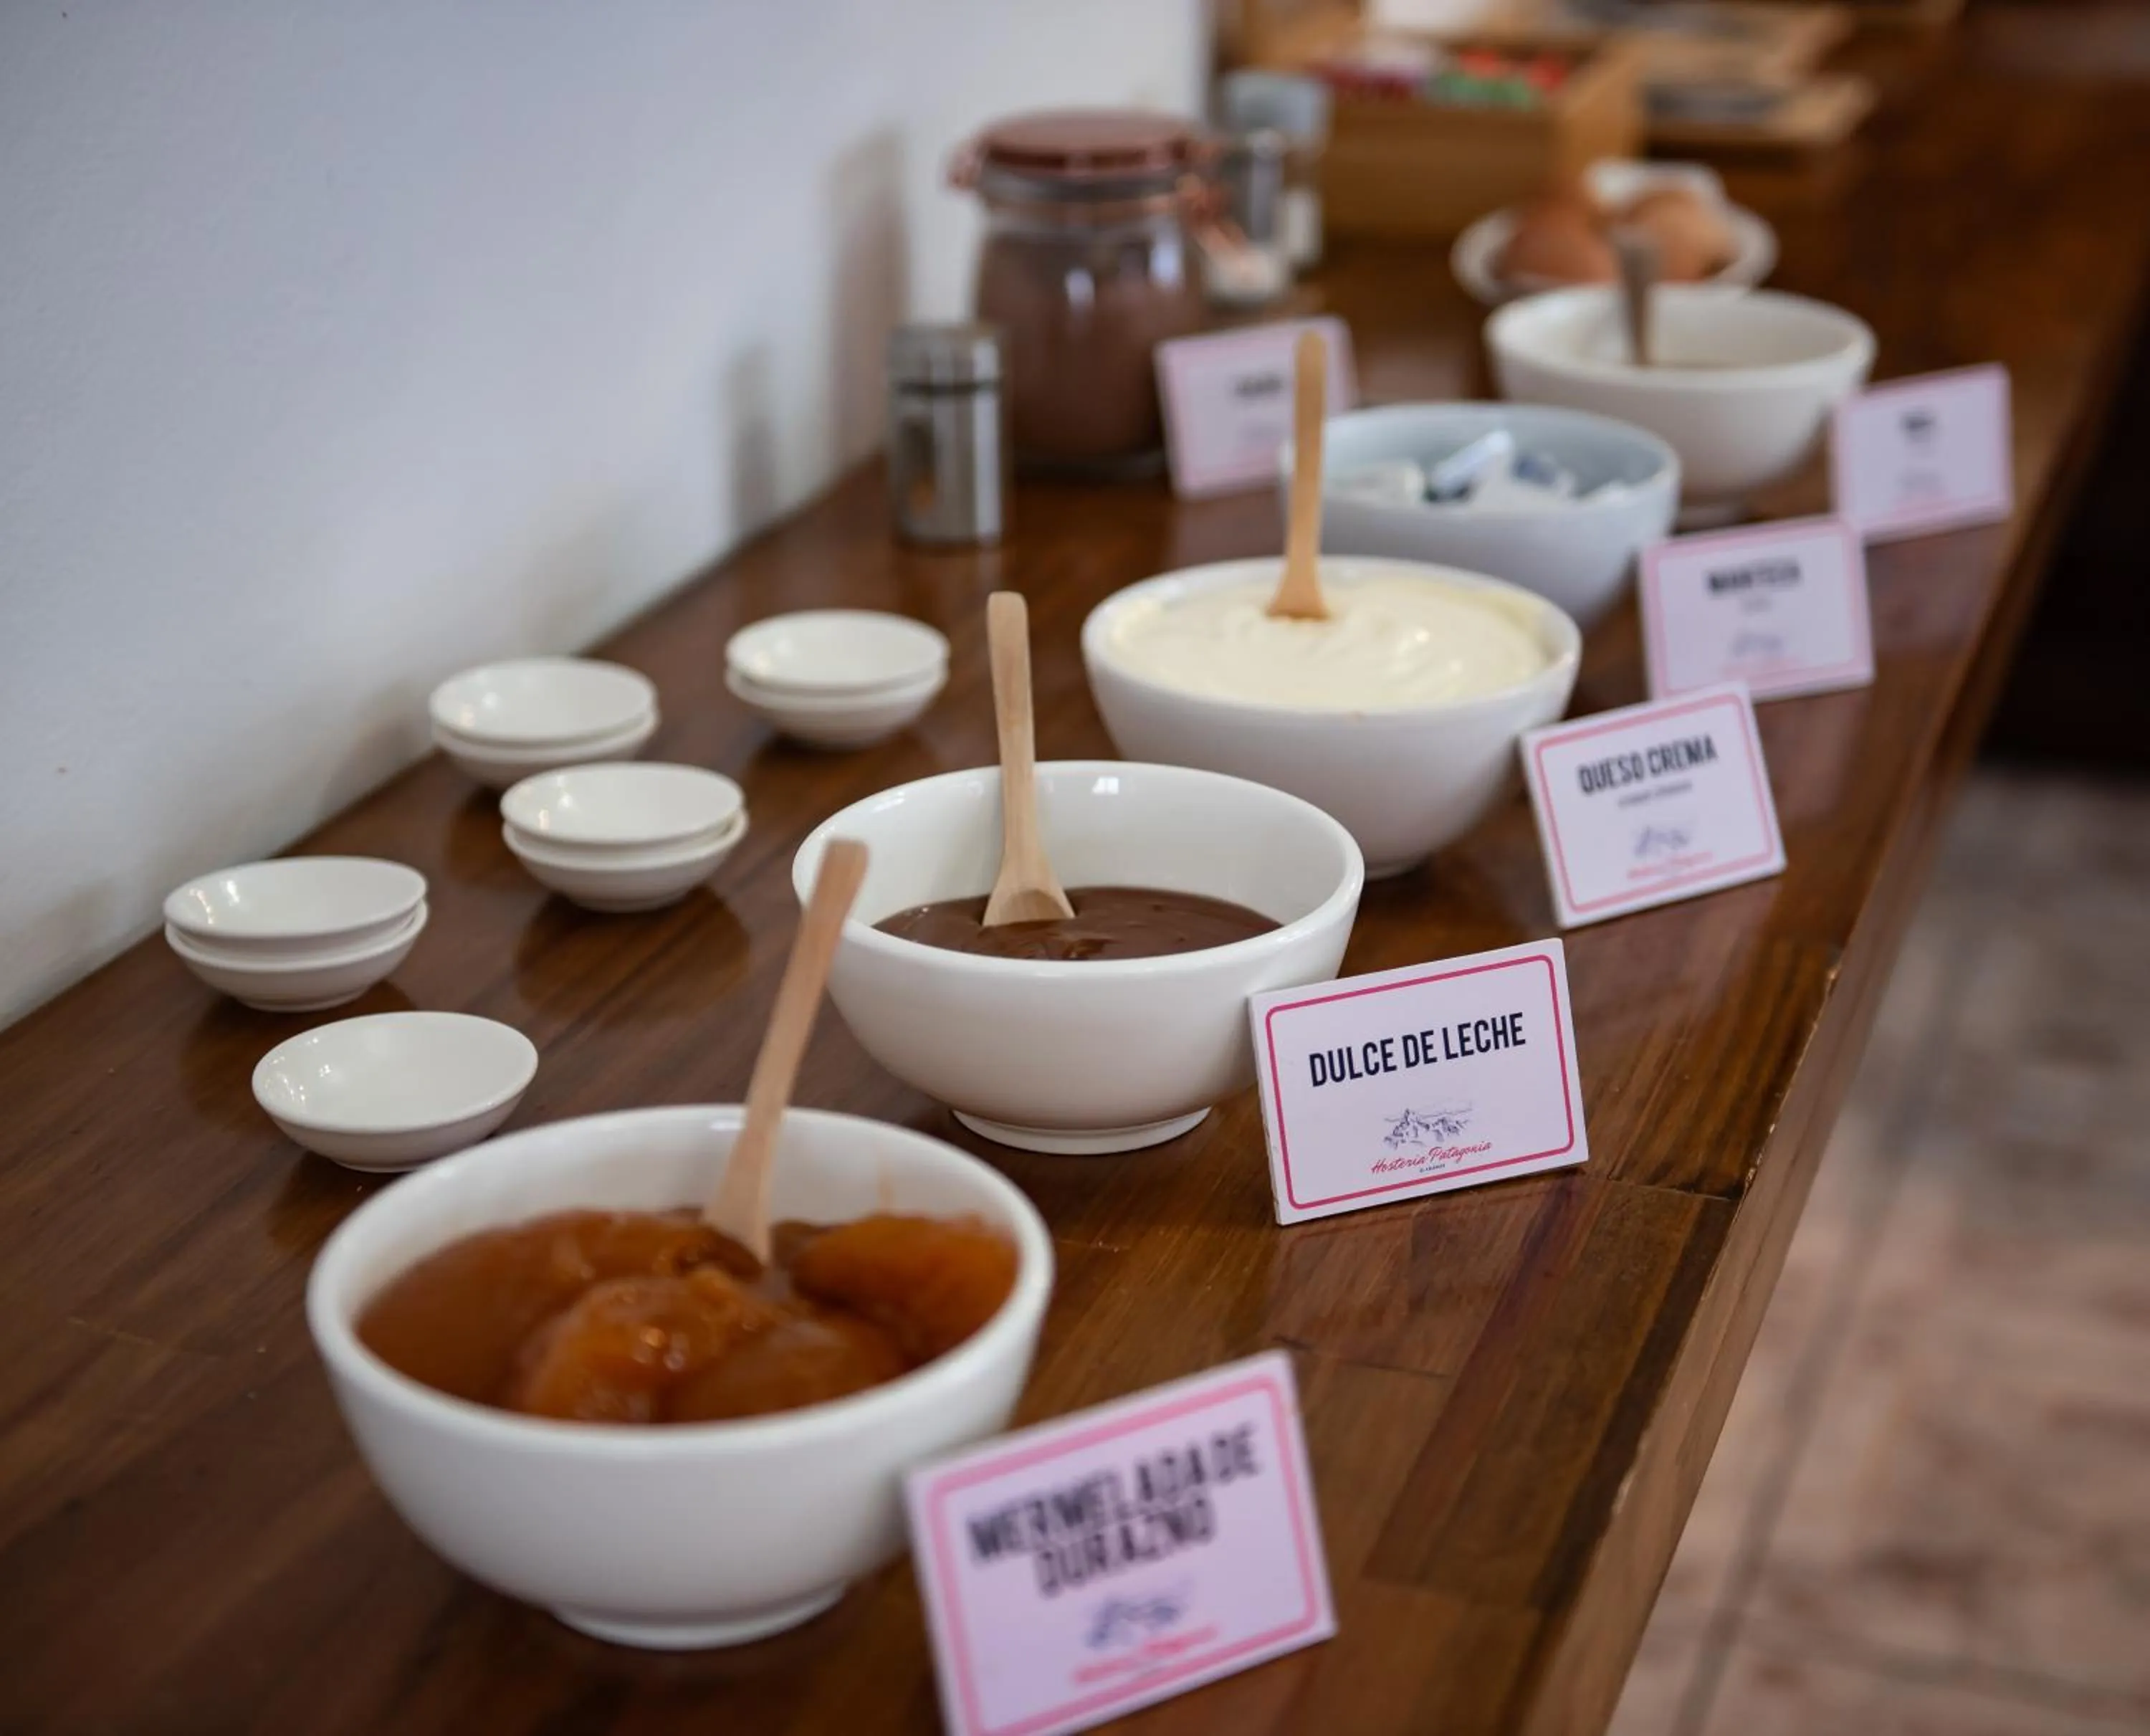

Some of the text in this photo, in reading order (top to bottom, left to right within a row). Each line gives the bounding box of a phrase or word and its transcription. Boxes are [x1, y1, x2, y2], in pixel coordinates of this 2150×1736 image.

[1577, 750, 1644, 795] QUESO
[1647, 733, 1719, 775] CREMA
[1309, 1012, 1526, 1087] DULCE DE LECHE
[1428, 1141, 1492, 1164] Patagonia
[966, 1422, 1261, 1565] MERMELADA DE
[1035, 1487, 1215, 1600] DURAZNO
